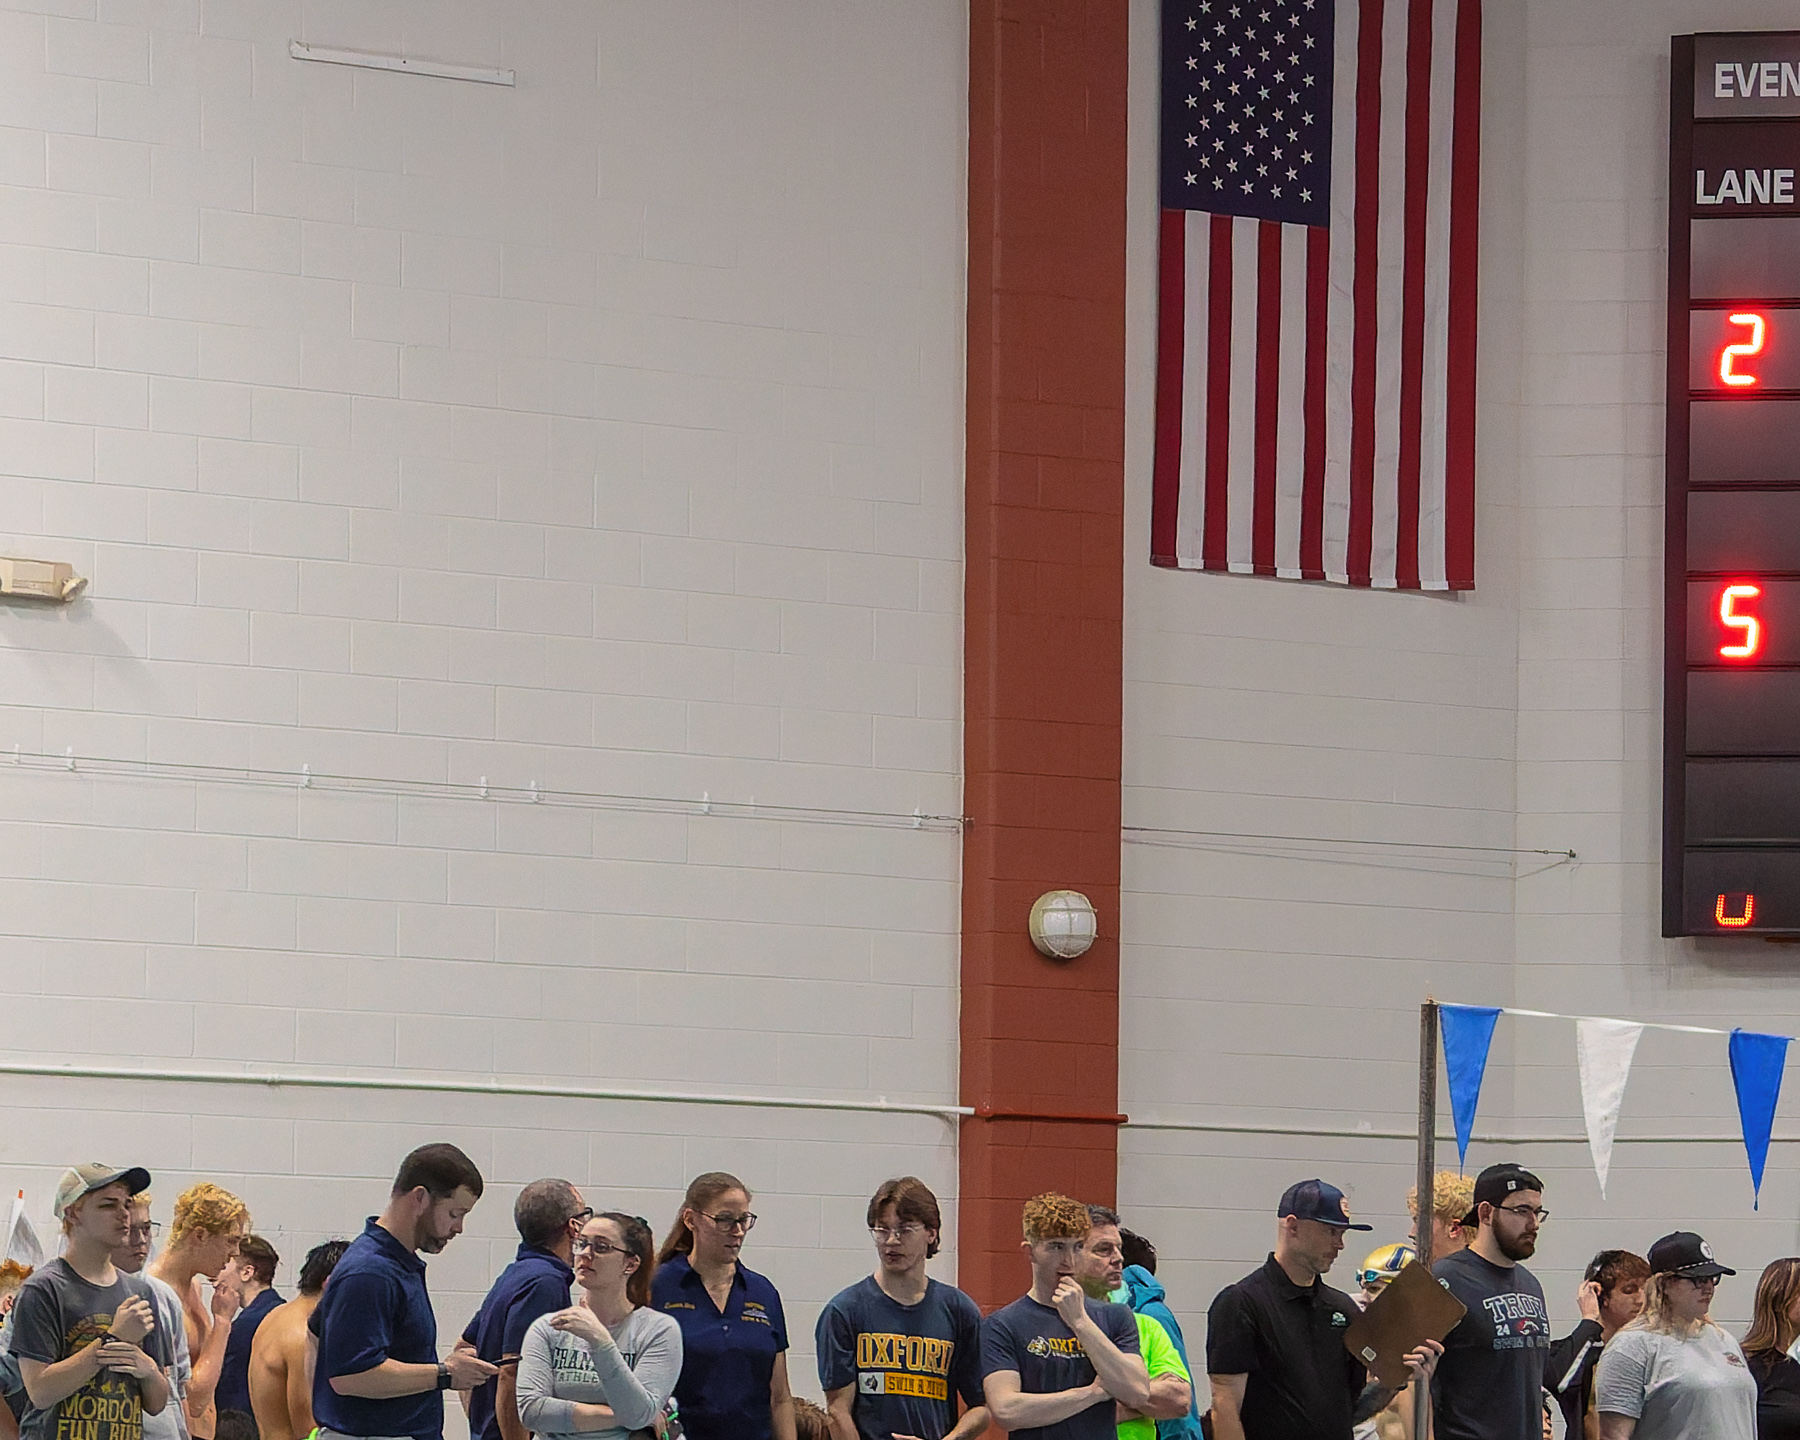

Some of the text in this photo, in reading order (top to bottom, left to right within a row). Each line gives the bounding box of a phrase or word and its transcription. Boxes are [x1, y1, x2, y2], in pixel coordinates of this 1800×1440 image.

[1695, 169, 1795, 204] LANE
[1719, 312, 1766, 387] 2
[1718, 584, 1762, 659] 5
[1482, 1293, 1547, 1323] TROY
[1495, 1323, 1511, 1336] 24
